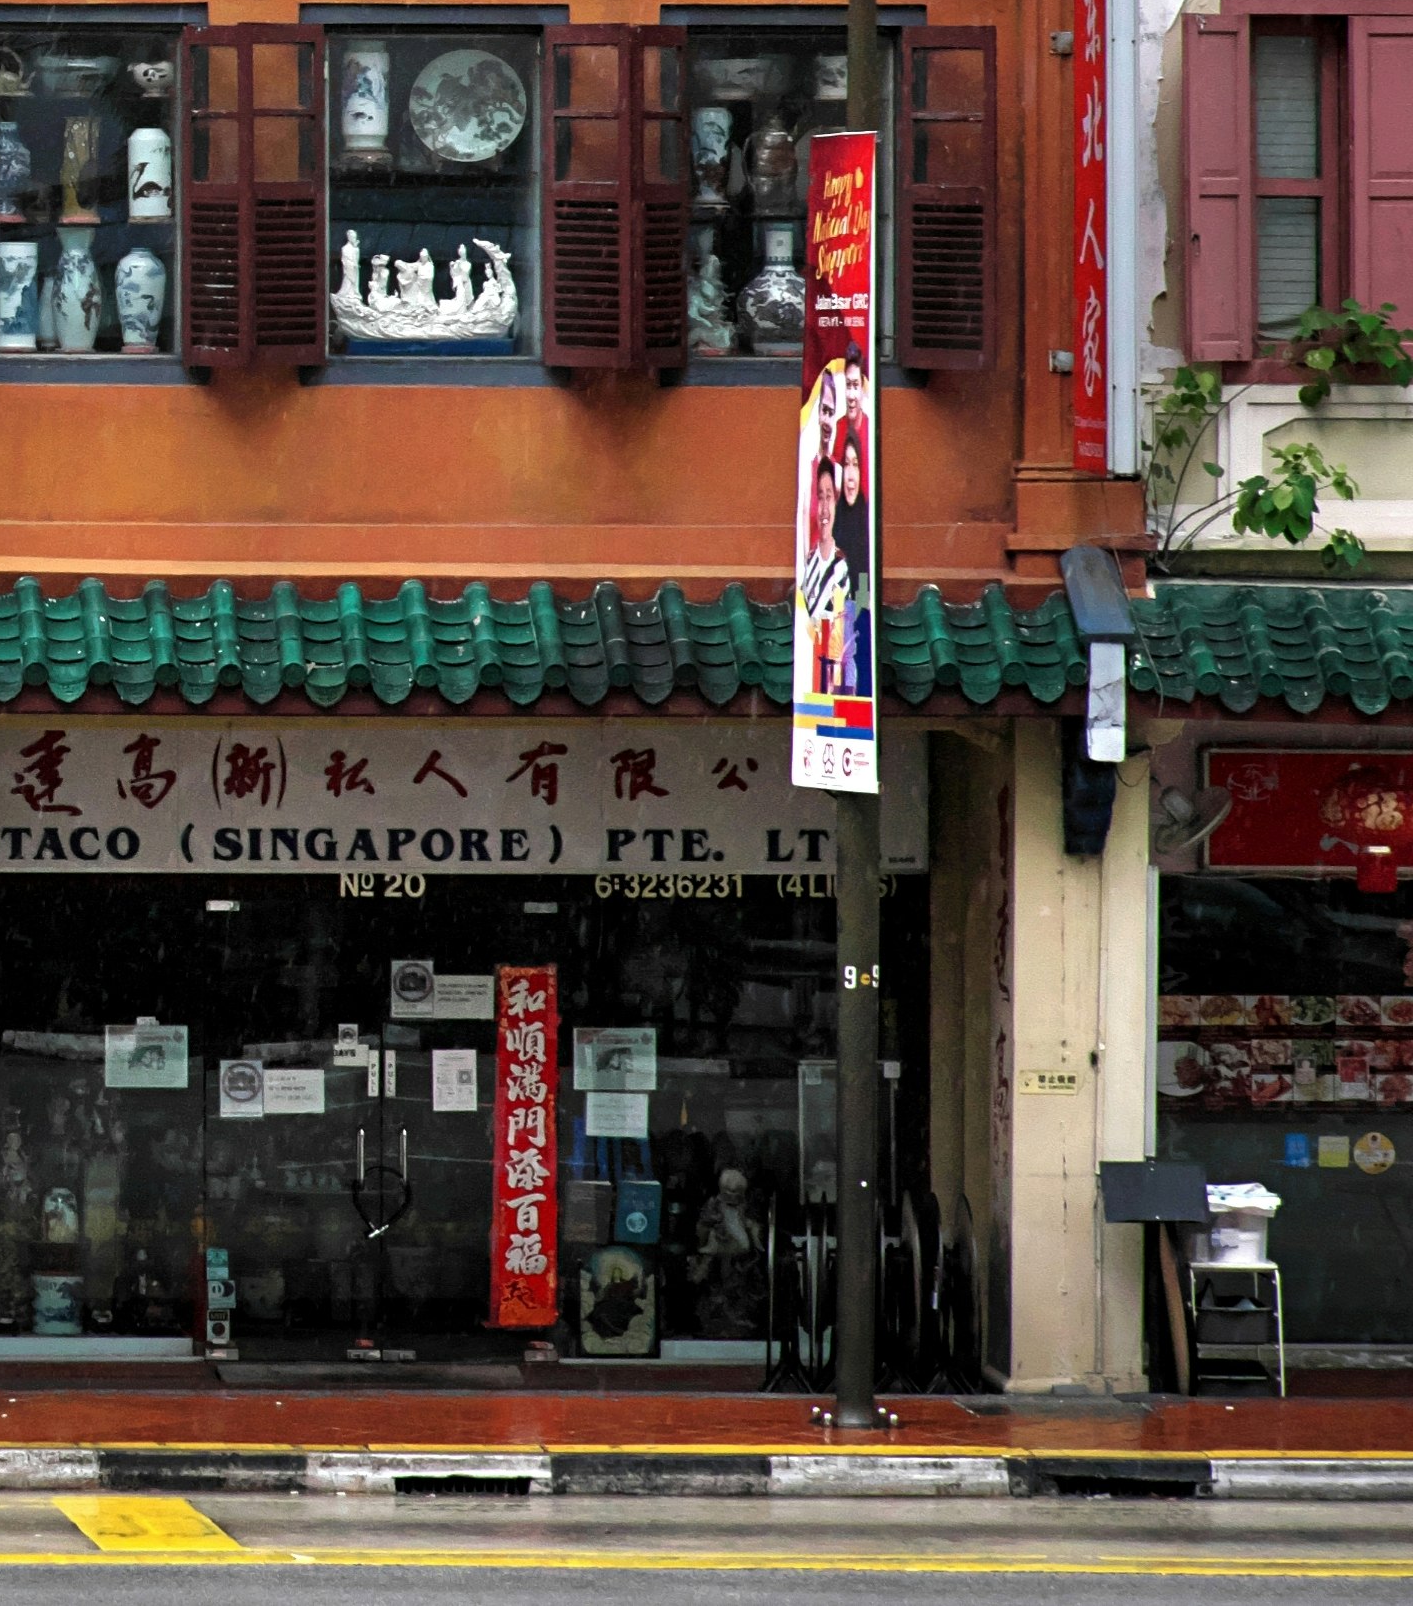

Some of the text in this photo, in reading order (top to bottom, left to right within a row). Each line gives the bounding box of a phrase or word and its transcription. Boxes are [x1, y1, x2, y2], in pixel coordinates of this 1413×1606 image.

[607, 828, 725, 863] PTE.
[766, 828, 833, 862] LT
[384, 872, 427, 898] 20
[844, 965, 857, 990] 9
